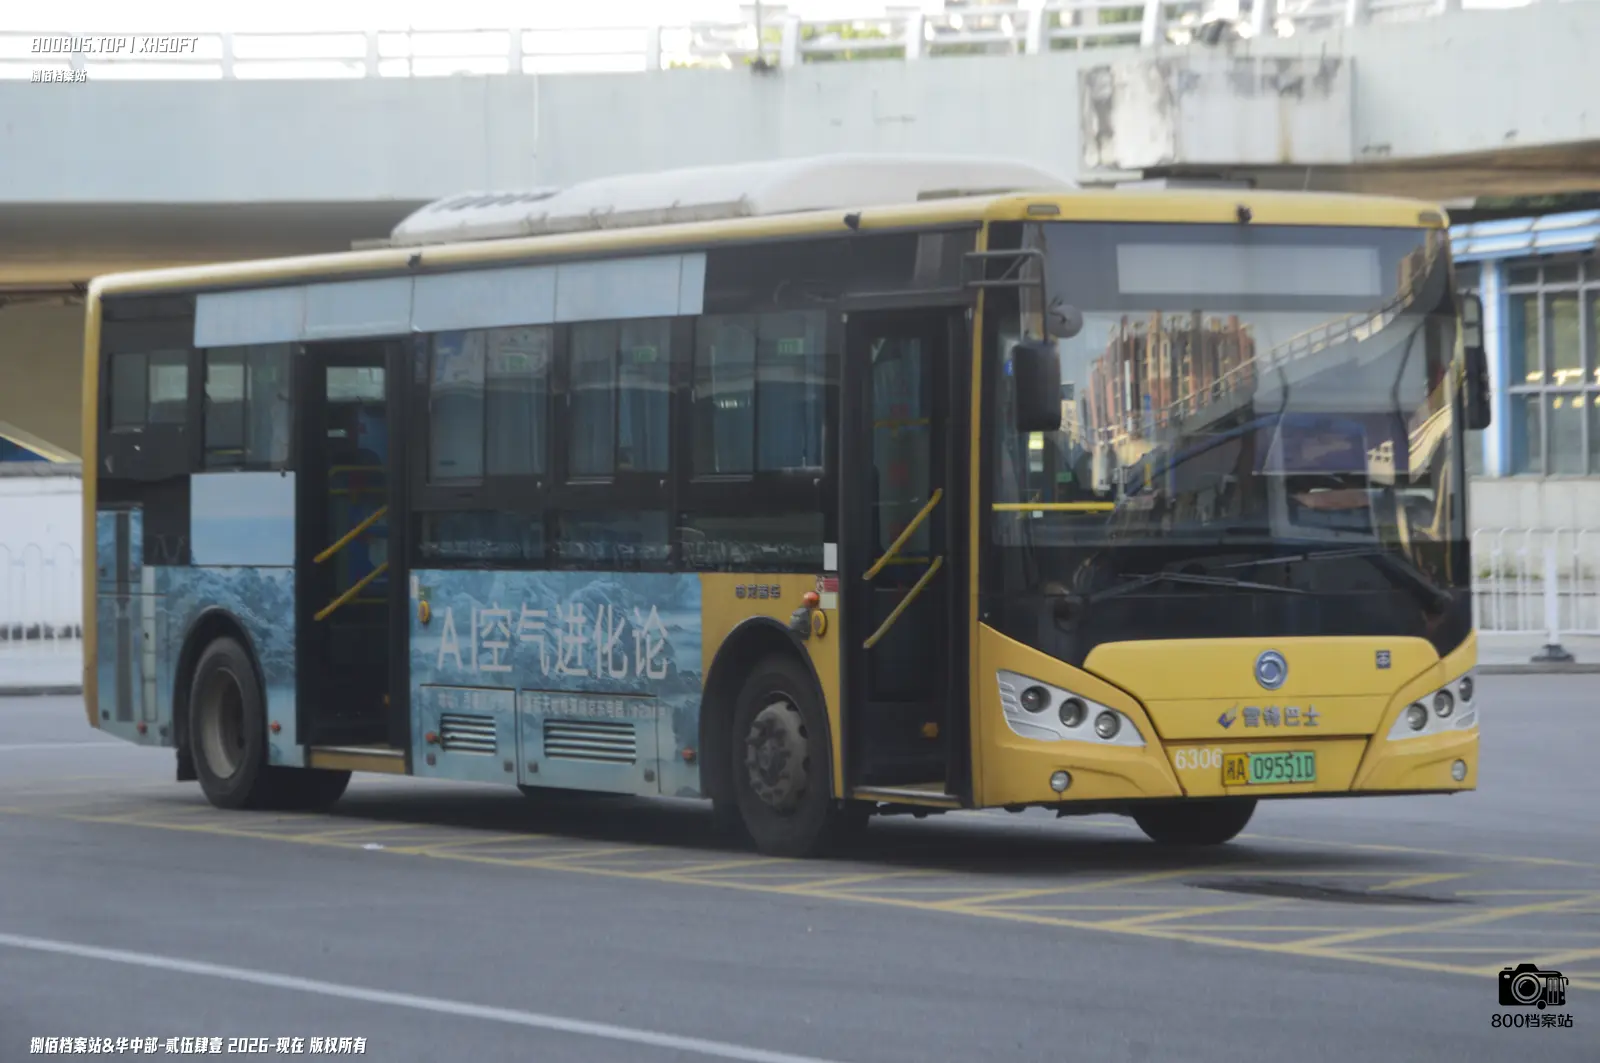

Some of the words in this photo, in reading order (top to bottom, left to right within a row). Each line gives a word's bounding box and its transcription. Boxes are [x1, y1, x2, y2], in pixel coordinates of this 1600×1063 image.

[437, 601, 669, 680] AI空气进化论
[1242, 704, 1321, 728] 雷锋巴士
[1174, 747, 1223, 770] 6306
